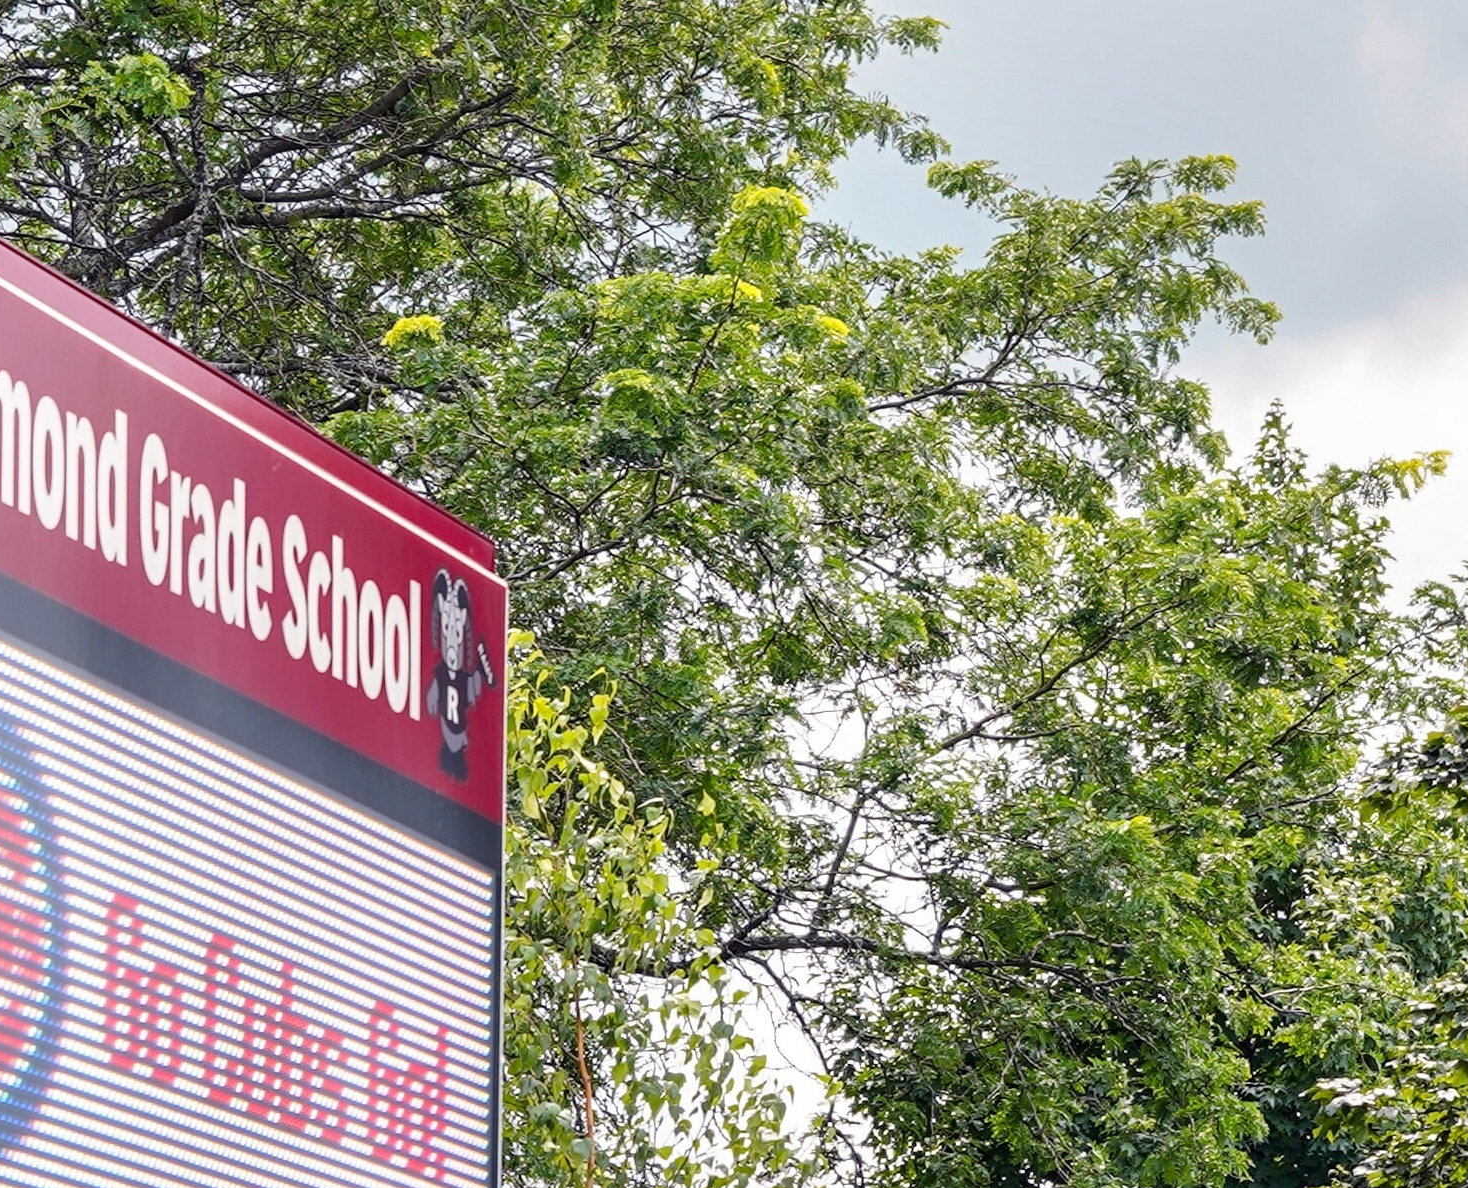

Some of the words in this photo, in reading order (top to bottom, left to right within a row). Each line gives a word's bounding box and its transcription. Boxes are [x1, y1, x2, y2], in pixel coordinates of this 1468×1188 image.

[139, 433, 273, 642] Grade
[282, 514, 421, 721] School
[447, 685, 459, 725] R
[105, 893, 182, 1086] Go
[204, 931, 349, 1141] Cubs
[369, 998, 447, 1181] Go!
